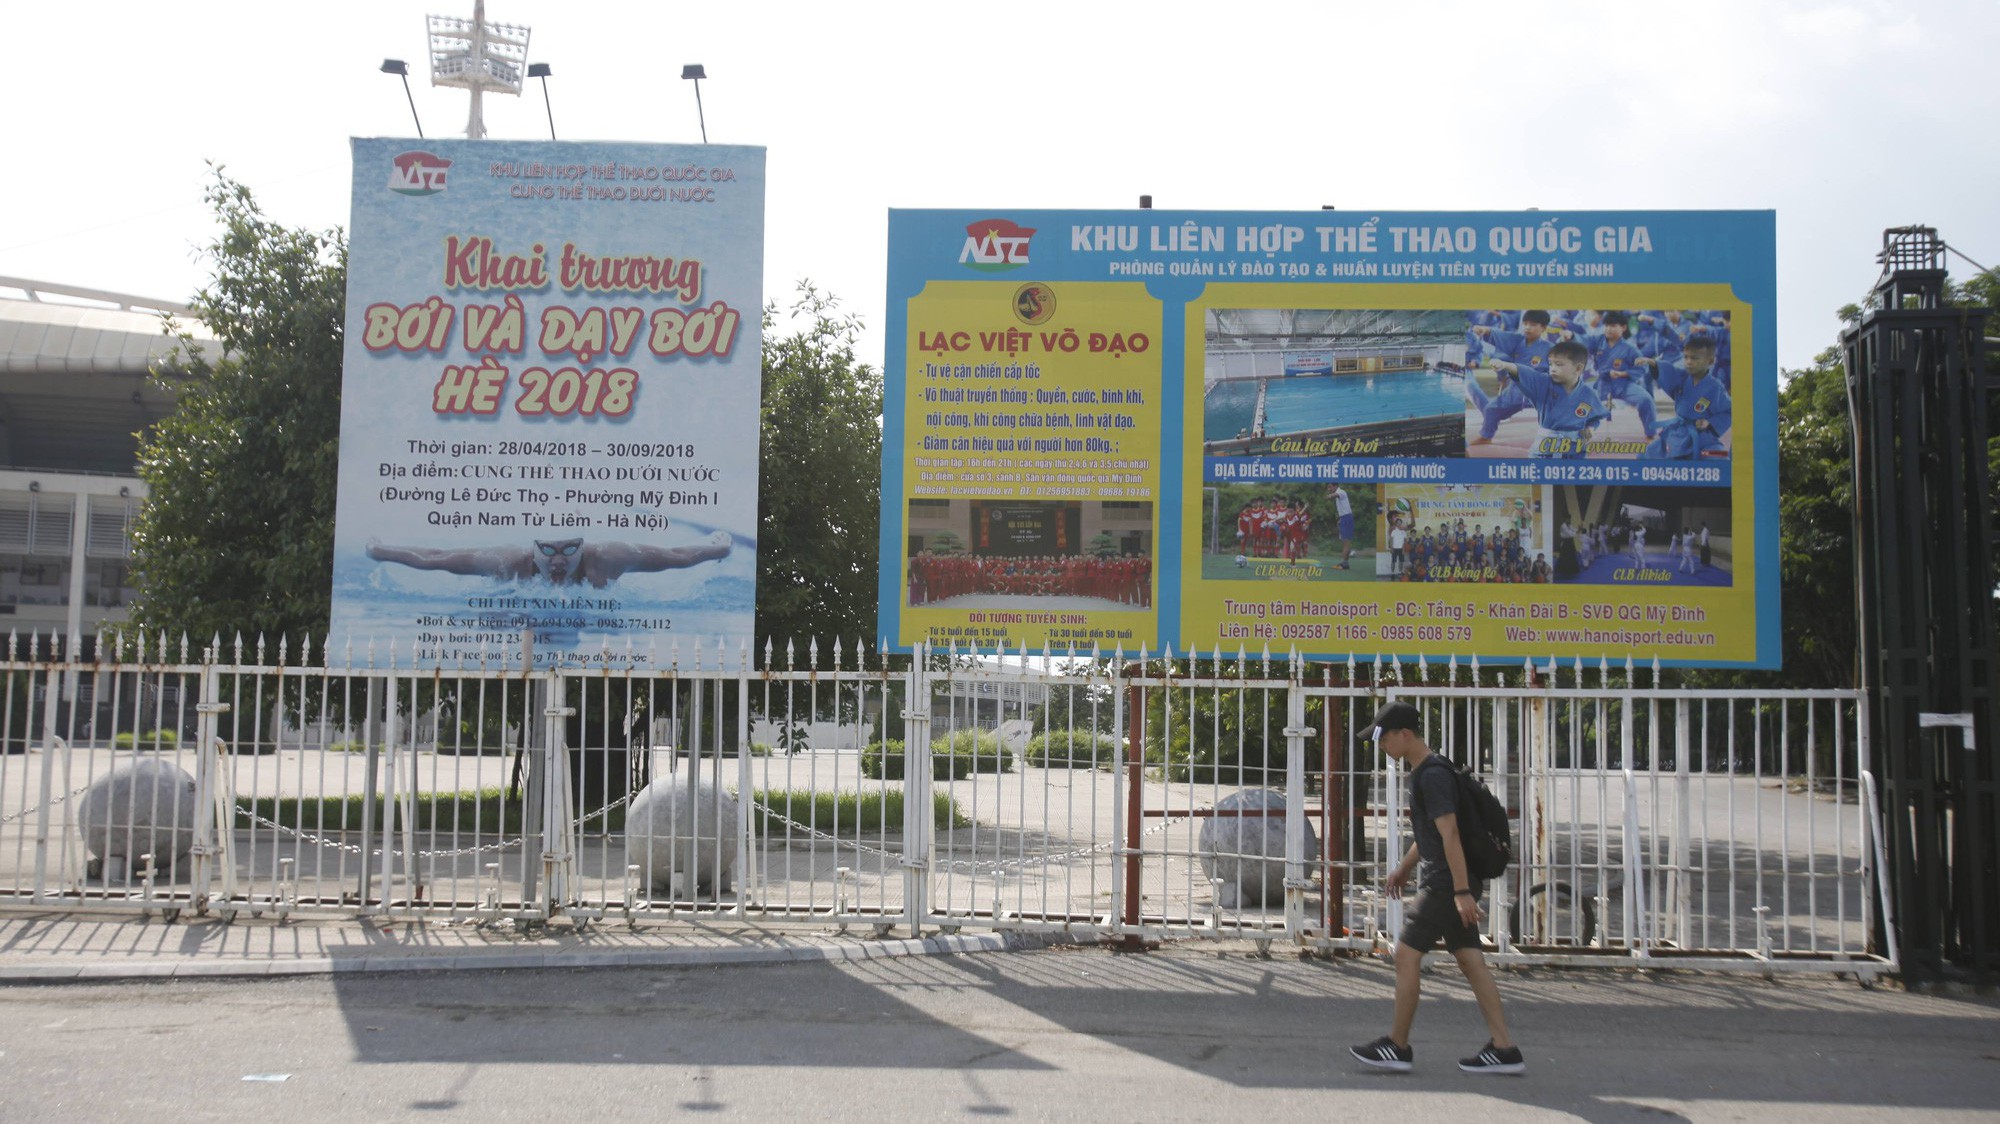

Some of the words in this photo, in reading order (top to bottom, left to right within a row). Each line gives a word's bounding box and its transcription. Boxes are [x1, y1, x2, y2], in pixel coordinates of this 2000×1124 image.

[489, 162, 520, 177] KHU
[524, 162, 552, 178] LIÊN
[619, 166, 658, 180] THAO
[710, 167, 736, 181] GIA
[510, 184, 554, 199] CUNG
[586, 185, 626, 200] THAO
[1071, 226, 1139, 251] KHU
[1150, 220, 1233, 252] LIÊN
[1237, 223, 1304, 258] HỢP
[1315, 216, 1380, 252] THỂ
[1389, 226, 1477, 253] THAO
[1488, 217, 1582, 256] QUỐC
[1594, 226, 1653, 253] GIA
[443, 235, 549, 290] Khai
[558, 241, 704, 305] trương
[1109, 258, 1165, 275] PHÒNG
[1169, 258, 1214, 277] QUẢN
[1218, 259, 1237, 275] LÝ
[1241, 260, 1275, 276] ĐÀO
[1279, 263, 1310, 279] TẠO
[1315, 263, 1327, 276] &
[1332, 258, 1378, 276] HUẤN
[1382, 260, 1434, 279] LUYỆN
[1479, 263, 1511, 280] TỤC
[1516, 258, 1569, 277] TUYỂN
[1573, 263, 1614, 276] SINH
[362, 295, 456, 352] BƠI
[463, 293, 525, 353] VÀ
[538, 306, 644, 364] DẠY
[649, 300, 740, 357] BƠI
[918, 331, 972, 357] LẠC
[978, 326, 1033, 357] VIỆT
[1040, 328, 1080, 352] VÕ
[1088, 332, 1150, 358] ĐẠO
[940, 363, 951, 382] vệ
[953, 364, 971, 382] cận
[974, 361, 1002, 379] chiến
[432, 355, 508, 414] HÈ
[514, 366, 639, 416] 2018
[925, 387, 938, 402] Võ
[940, 387, 964, 405] thuật
[1000, 386, 1028, 405] thống
[926, 411, 942, 429] nội
[992, 412, 1015, 429] công
[408, 439, 449, 455] Thời
[452, 441, 492, 457] gian:
[498, 441, 587, 457] 28/04/2018
[607, 442, 694, 459] 30/09/2018
[972, 436, 994, 454] hiệu
[1017, 436, 1032, 452] với
[1064, 437, 1083, 452] hơn
[1085, 438, 1113, 454] 80kg.
[1271, 437, 1301, 453] Câu
[1331, 437, 1351, 456] bộ
[1354, 437, 1380, 453] bơi
[1539, 437, 1571, 453] CLB
[1575, 437, 1647, 453] Vovinam
[379, 462, 411, 481] Địa
[412, 460, 459, 479] điểm:
[461, 464, 512, 480] CUNG
[559, 465, 611, 481] THAO
[615, 463, 662, 482] DƯỚI
[667, 464, 720, 483] NƯỚC
[1215, 463, 1236, 481] ĐỊA
[1239, 458, 1275, 478] ĐIỂM:
[1278, 464, 1313, 478] CUNG
[1316, 459, 1340, 478] THỂ
[1343, 464, 1374, 478] THAO
[1378, 463, 1407, 479] DƯỚI
[1411, 462, 1446, 479] NƯỚC
[1488, 462, 1517, 479] LIÊN
[1520, 463, 1541, 482] HỆ:
[1544, 466, 1575, 480] 0912
[1579, 466, 1602, 480] 234
[1605, 467, 1630, 480] 015
[1641, 467, 1720, 482] 0945481288
[379, 486, 446, 505] (Đường
[450, 486, 472, 503] Lê
[476, 487, 511, 504] Đức
[517, 488, 550, 508] Thọ
[565, 489, 636, 507] Phường
[640, 489, 664, 509] Mỹ
[668, 488, 708, 506] Đình
[427, 511, 472, 530] Quận
[478, 512, 516, 527] Nam
[521, 510, 546, 528] Từ
[550, 510, 591, 528] Liêm
[607, 511, 629, 528] Hà
[634, 512, 670, 532] Nội)
[1430, 565, 1452, 578] CLB
[1613, 568, 1635, 581] CLB
[468, 597, 493, 608] CHI
[532, 597, 557, 609] XIN
[561, 596, 593, 610] LIÊN
[1224, 600, 1266, 619] Trung
[1270, 600, 1296, 616] tâm
[1300, 601, 1378, 620] Hanoisport
[1395, 602, 1422, 617] ĐC:
[1426, 600, 1462, 621] Tầng
[1466, 603, 1475, 618] 5
[1488, 602, 1526, 619] Khán
[1530, 602, 1553, 619] Đài
[1558, 604, 1568, 618] B
[1582, 604, 1613, 620] SVĐ
[1618, 604, 1642, 621] QG
[1645, 604, 1667, 624] Mỹ
[1671, 605, 1705, 621] Đình
[447, 617, 456, 627] &
[597, 618, 671, 630] 0982.774.112
[1060, 614, 1088, 625] SINH:
[940, 627, 946, 635] 5
[981, 628, 990, 636] 15
[1061, 629, 1070, 638] 30
[1105, 630, 1116, 639] 50
[1219, 622, 1249, 638] Liên
[1254, 622, 1277, 642] Hệ:
[1281, 624, 1331, 639] 092587
[1336, 625, 1368, 640] 1166
[1381, 625, 1414, 640] 0985
[1418, 626, 1443, 641] 608
[1446, 626, 1472, 641] 579
[1505, 626, 1541, 642] Web:
[1545, 628, 1715, 647] www.hanoisport.edu.vn
[985, 639, 995, 647] 30
